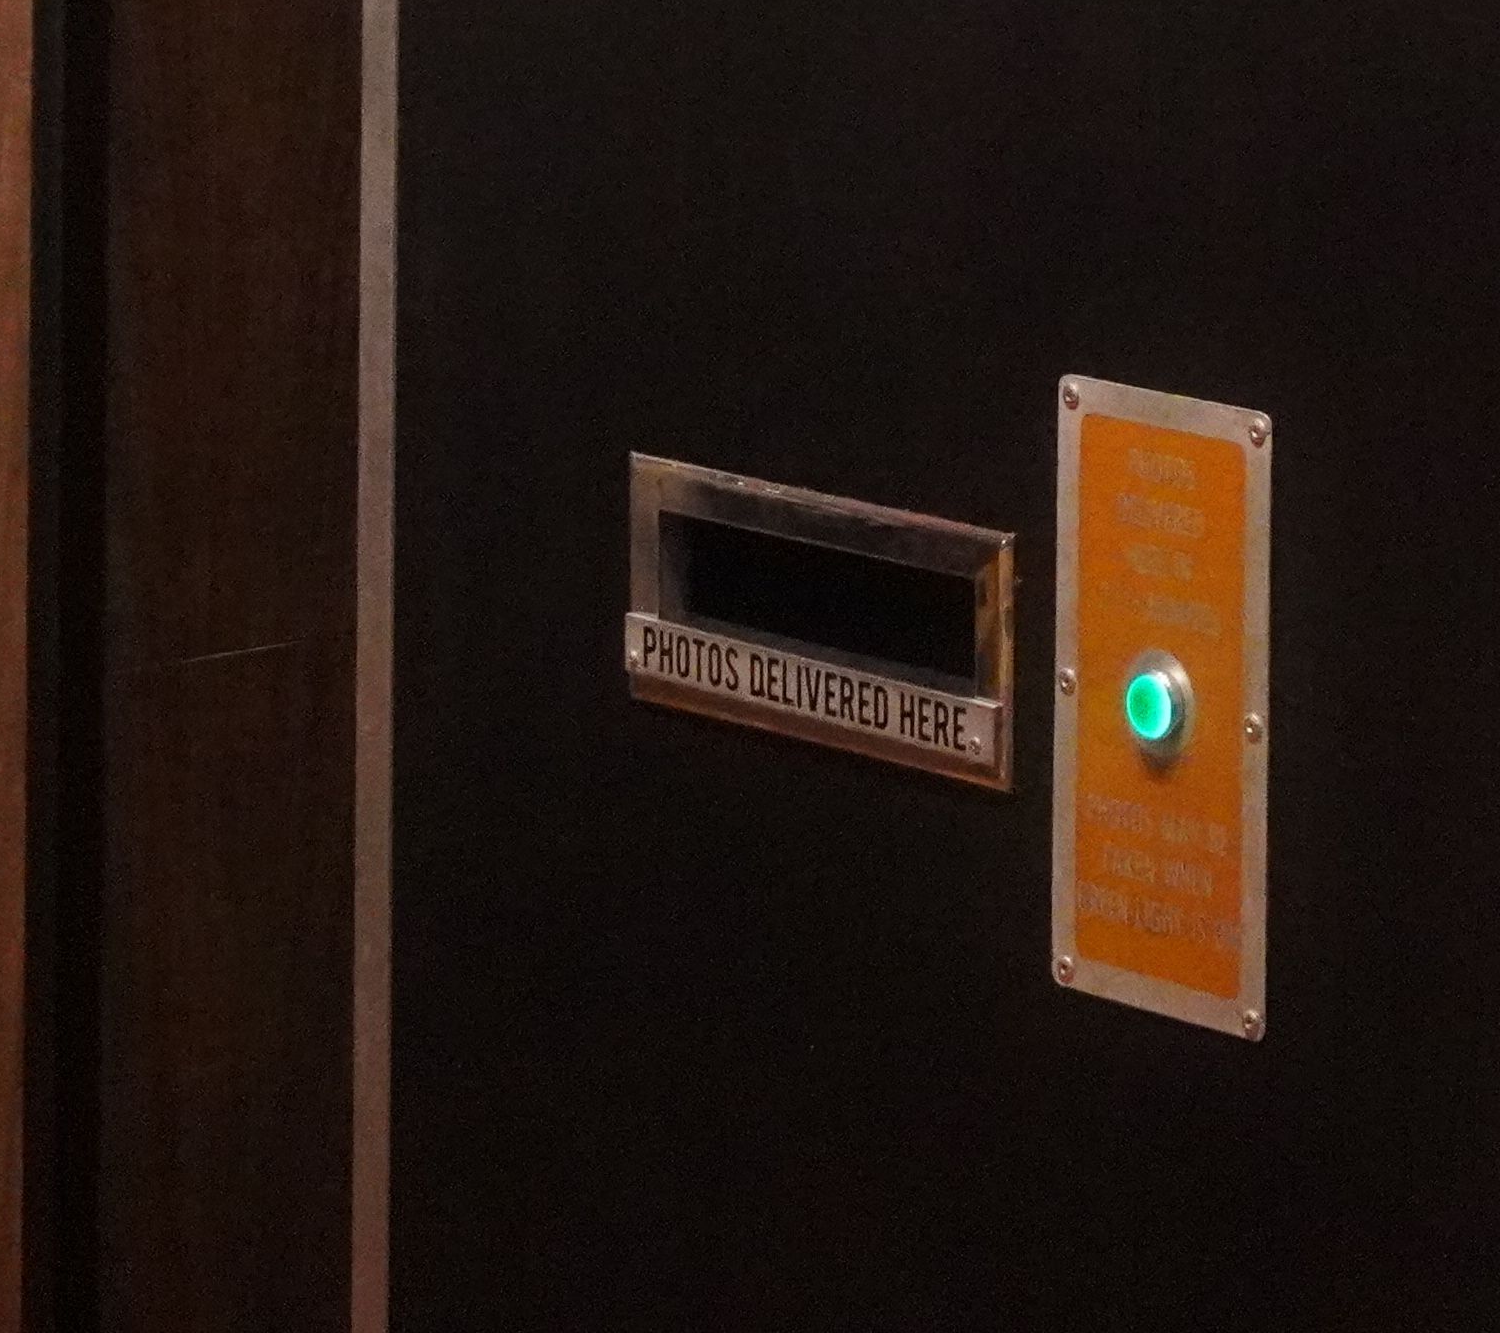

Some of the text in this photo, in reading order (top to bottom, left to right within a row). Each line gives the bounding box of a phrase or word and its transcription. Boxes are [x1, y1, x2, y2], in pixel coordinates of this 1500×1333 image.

[642, 626, 967, 752] PHOTOS DELIVERED HERE
